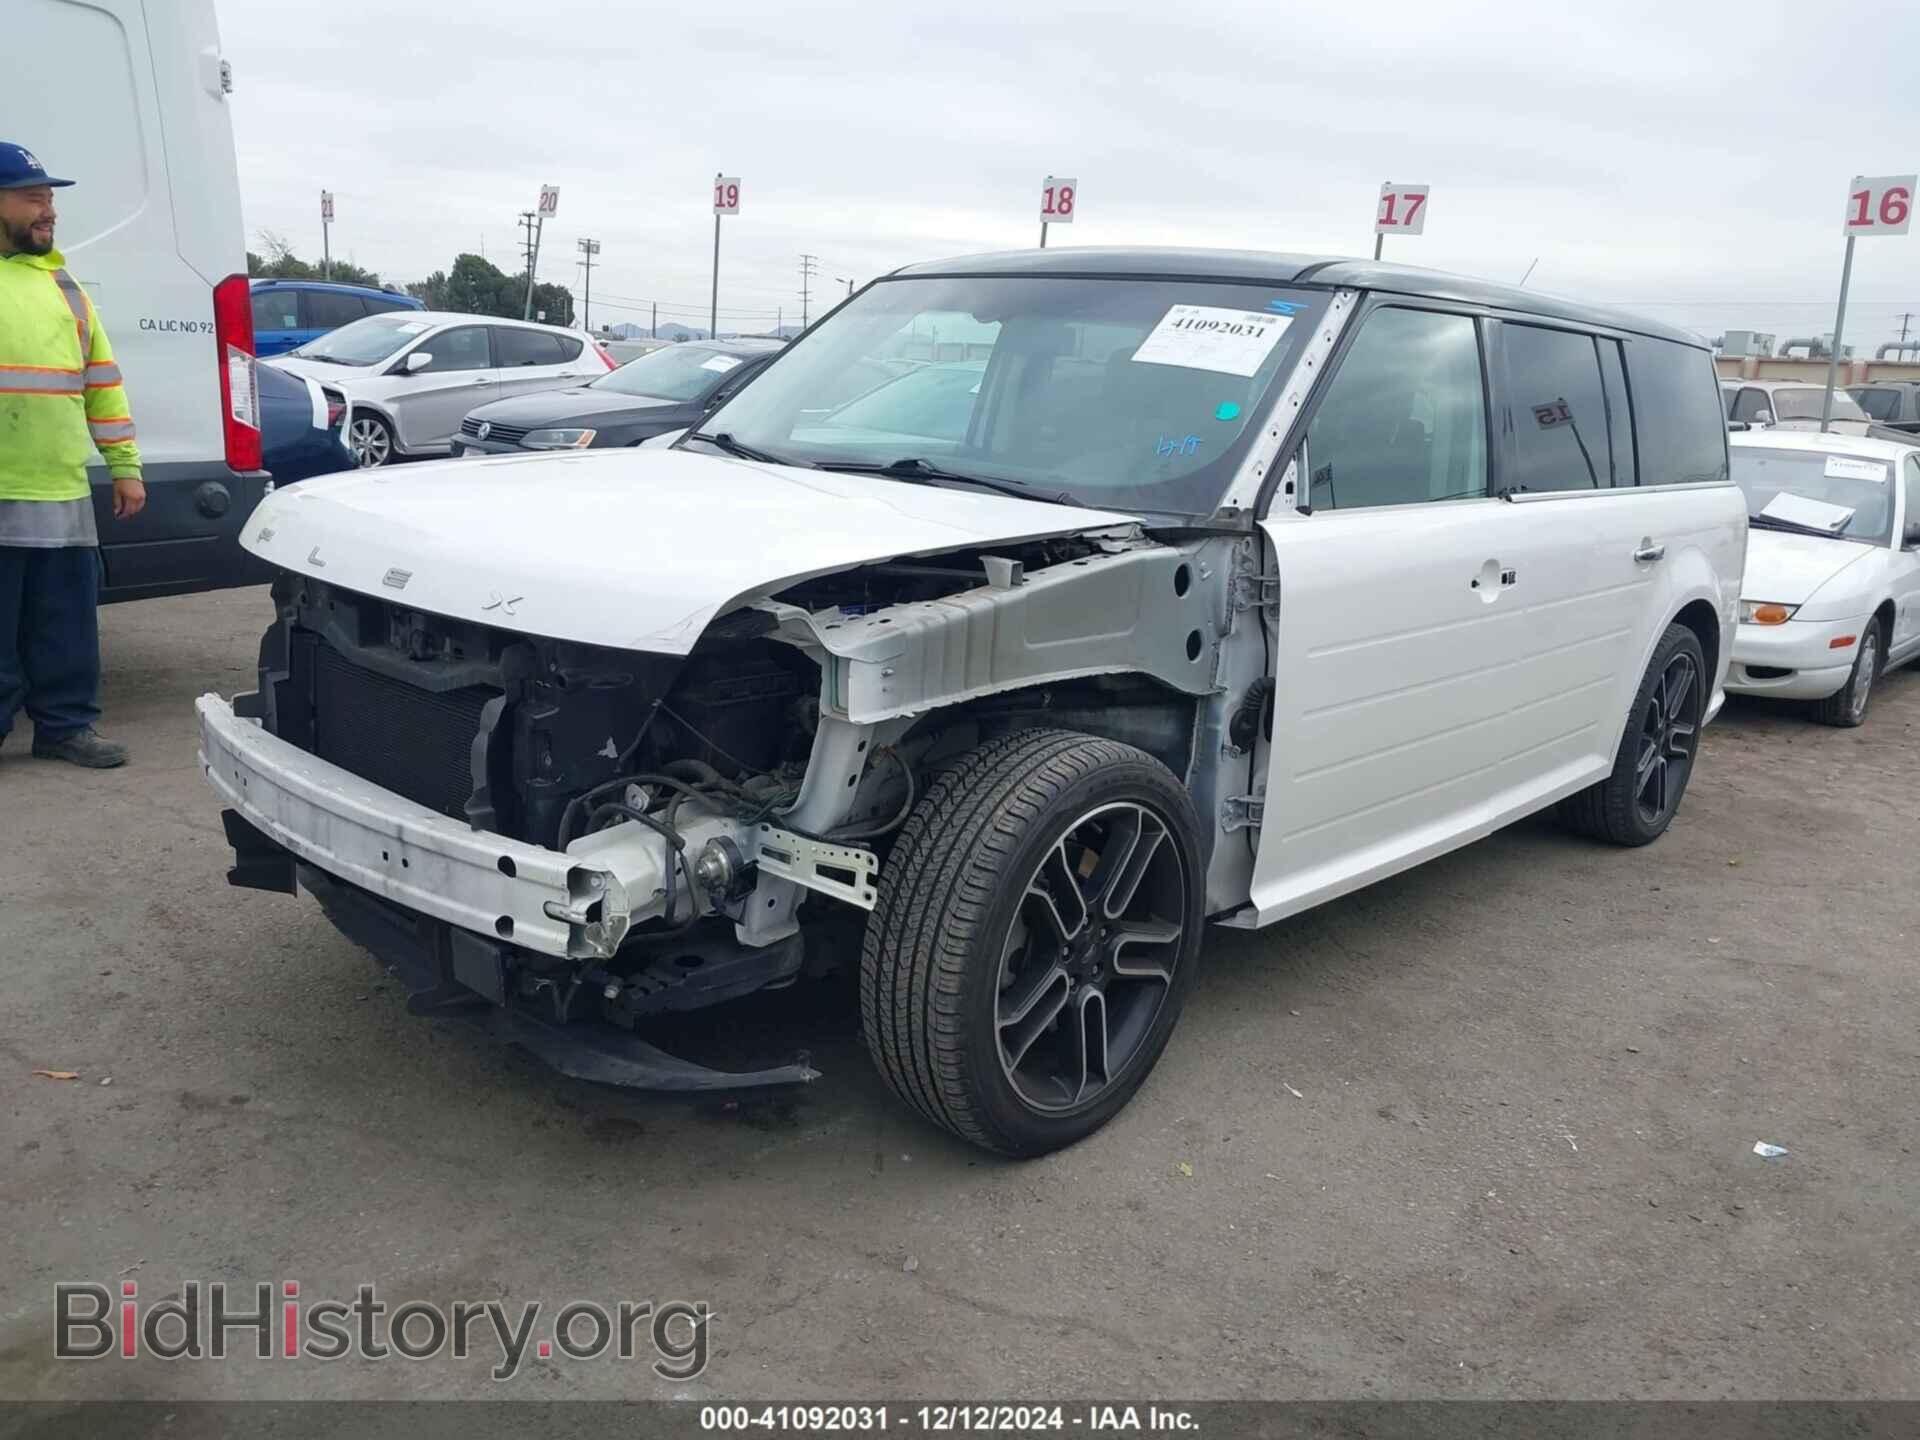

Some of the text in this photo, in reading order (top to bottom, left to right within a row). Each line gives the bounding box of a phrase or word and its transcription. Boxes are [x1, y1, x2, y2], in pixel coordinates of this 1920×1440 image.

[539, 191, 558, 211] 20
[715, 184, 738, 208] 19
[1042, 187, 1073, 214] 18
[1848, 187, 1909, 225] 16
[321, 199, 334, 218] 21
[1378, 193, 1425, 225] 17
[139, 318, 214, 334] CA LIC NO 92
[1172, 317, 1265, 339] 41092031
